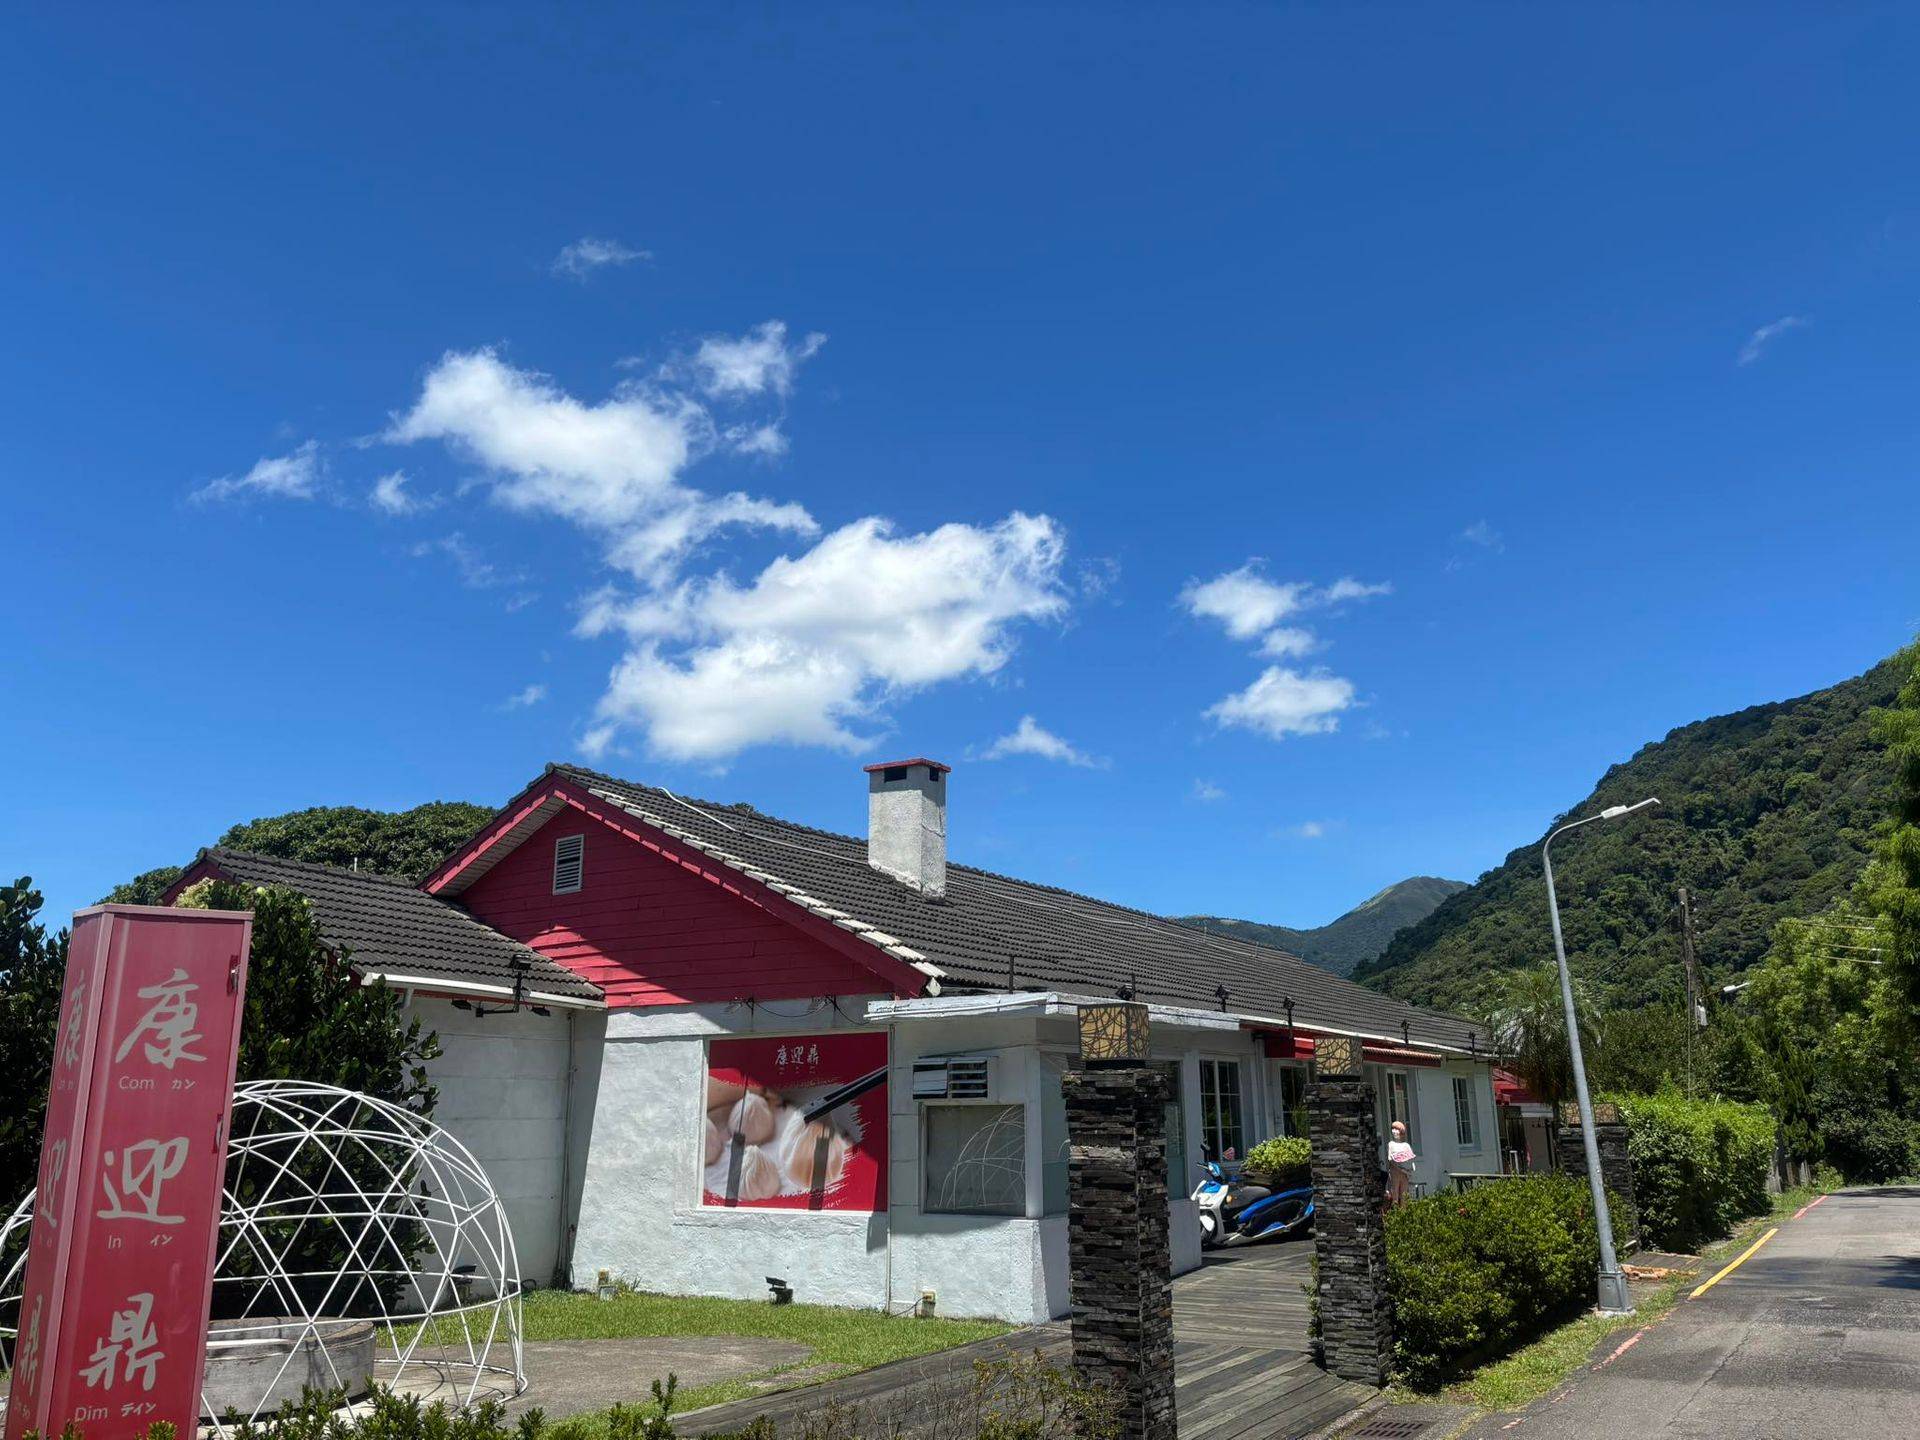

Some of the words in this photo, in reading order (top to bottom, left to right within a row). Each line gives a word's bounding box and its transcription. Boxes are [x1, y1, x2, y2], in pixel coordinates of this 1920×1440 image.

[115, 969, 207, 1068] 康
[775, 1044, 819, 1065] 康迎鼎
[120, 1076, 154, 1089] Com
[172, 1079, 196, 1089] カン
[97, 1137, 188, 1224] 迎
[108, 1235, 122, 1248] In
[150, 1234, 172, 1246] イン
[79, 1292, 165, 1390] 鼎
[75, 1406, 108, 1421] Dim
